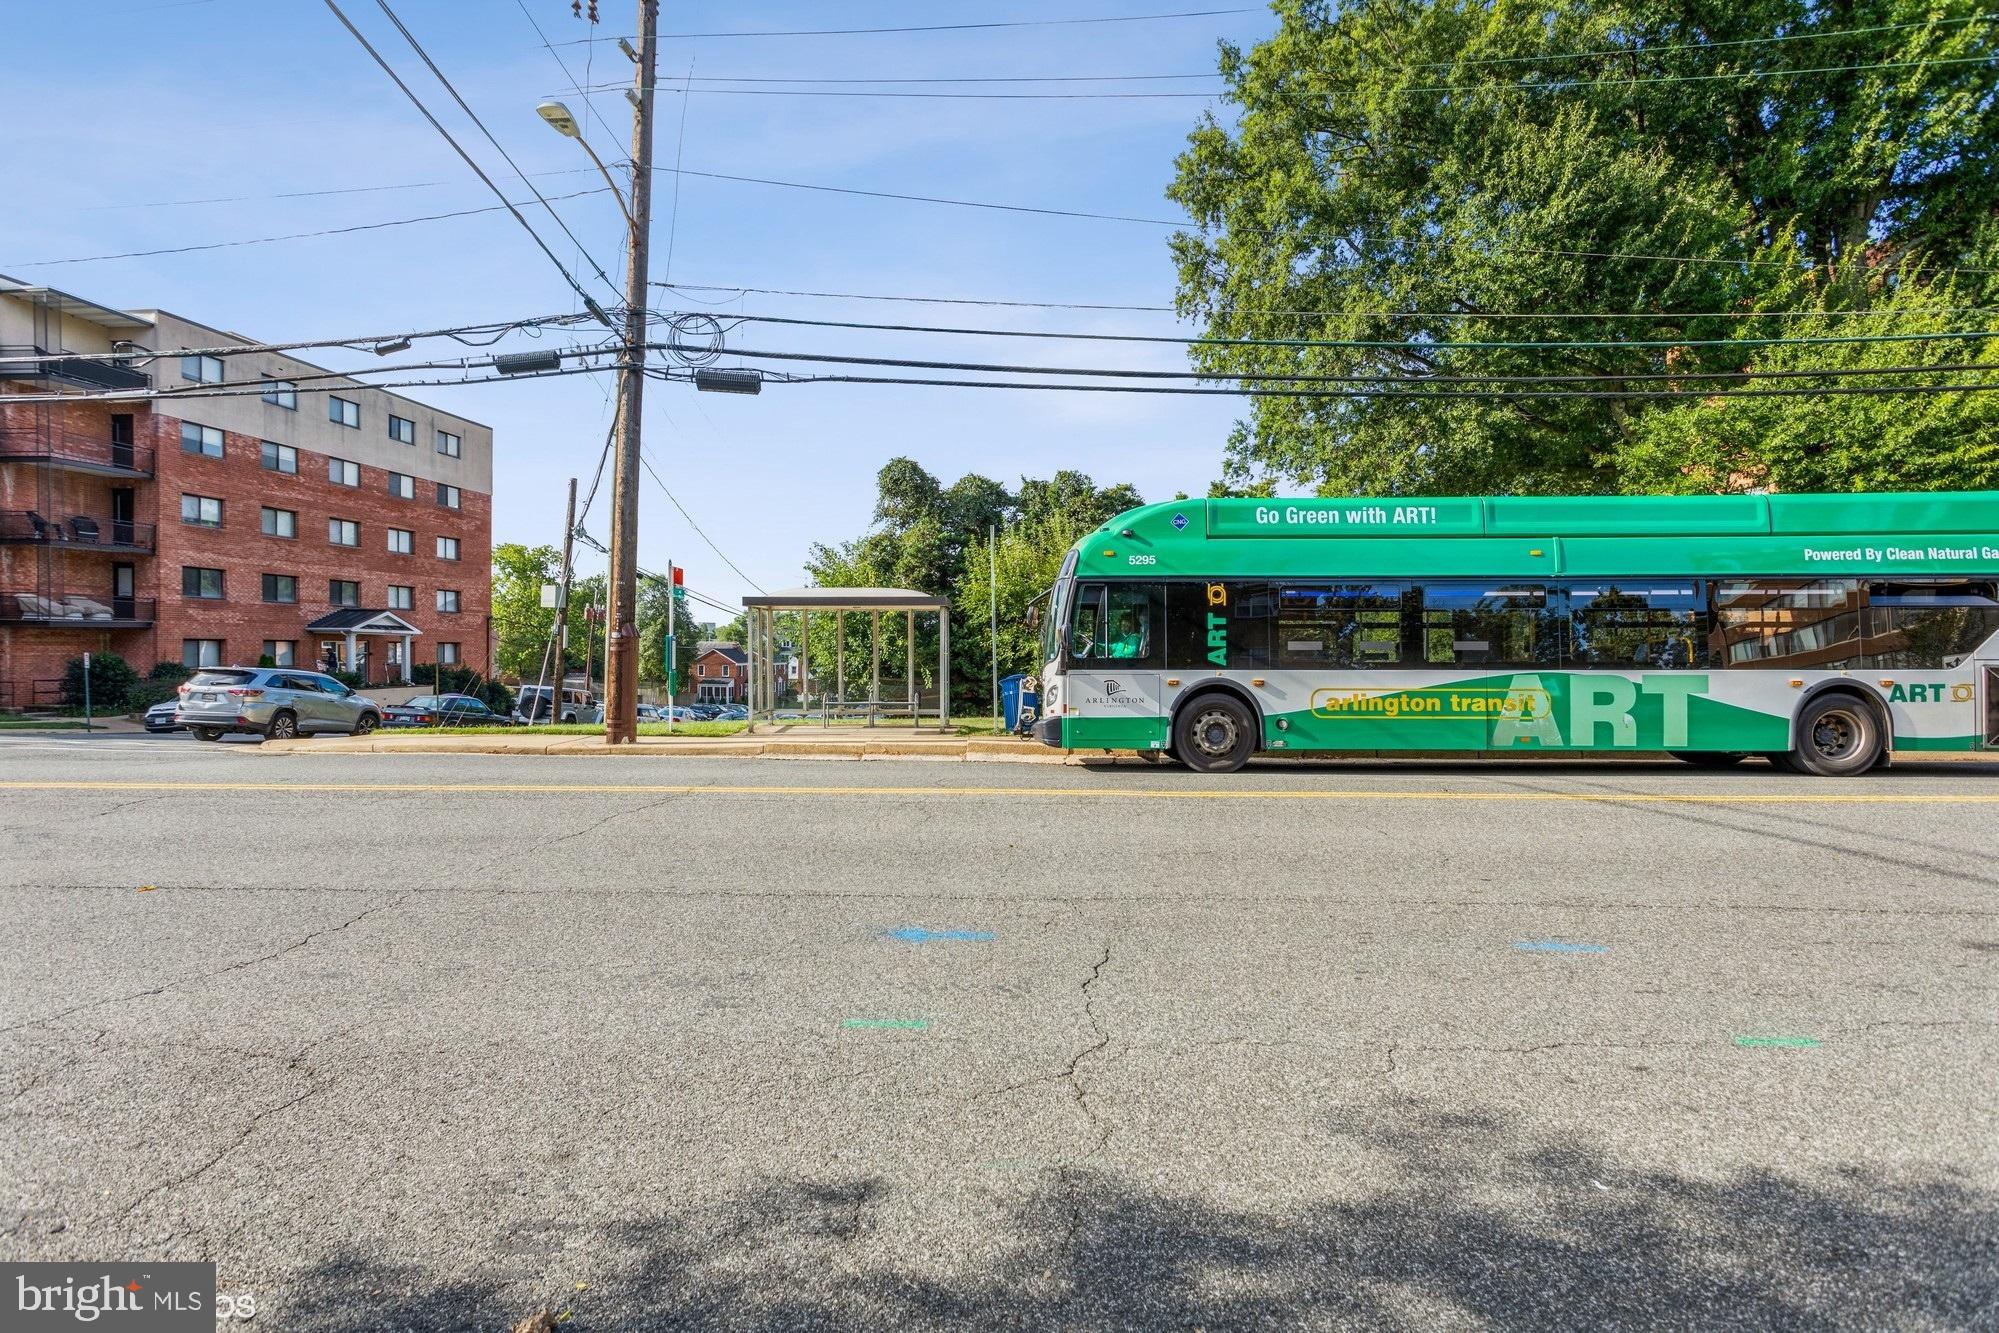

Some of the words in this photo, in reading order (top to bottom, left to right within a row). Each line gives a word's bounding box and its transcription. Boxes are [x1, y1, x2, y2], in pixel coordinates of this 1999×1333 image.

[1256, 507, 1279, 524] Go
[1286, 507, 1339, 524] Green
[1345, 507, 1386, 524] with
[1393, 507, 1436, 524] ART!
[1128, 555, 1156, 565] 5295
[1804, 548, 1861, 560] Powered
[1865, 548, 1882, 562] By
[1886, 548, 1924, 560] Clean
[1928, 547, 1977, 560] Natural
[1208, 613, 1226, 666] ART
[1889, 684, 1945, 702] ART
[1326, 693, 1441, 717] arlington
[1450, 694, 1536, 712] transit
[1492, 674, 1709, 746] ART
